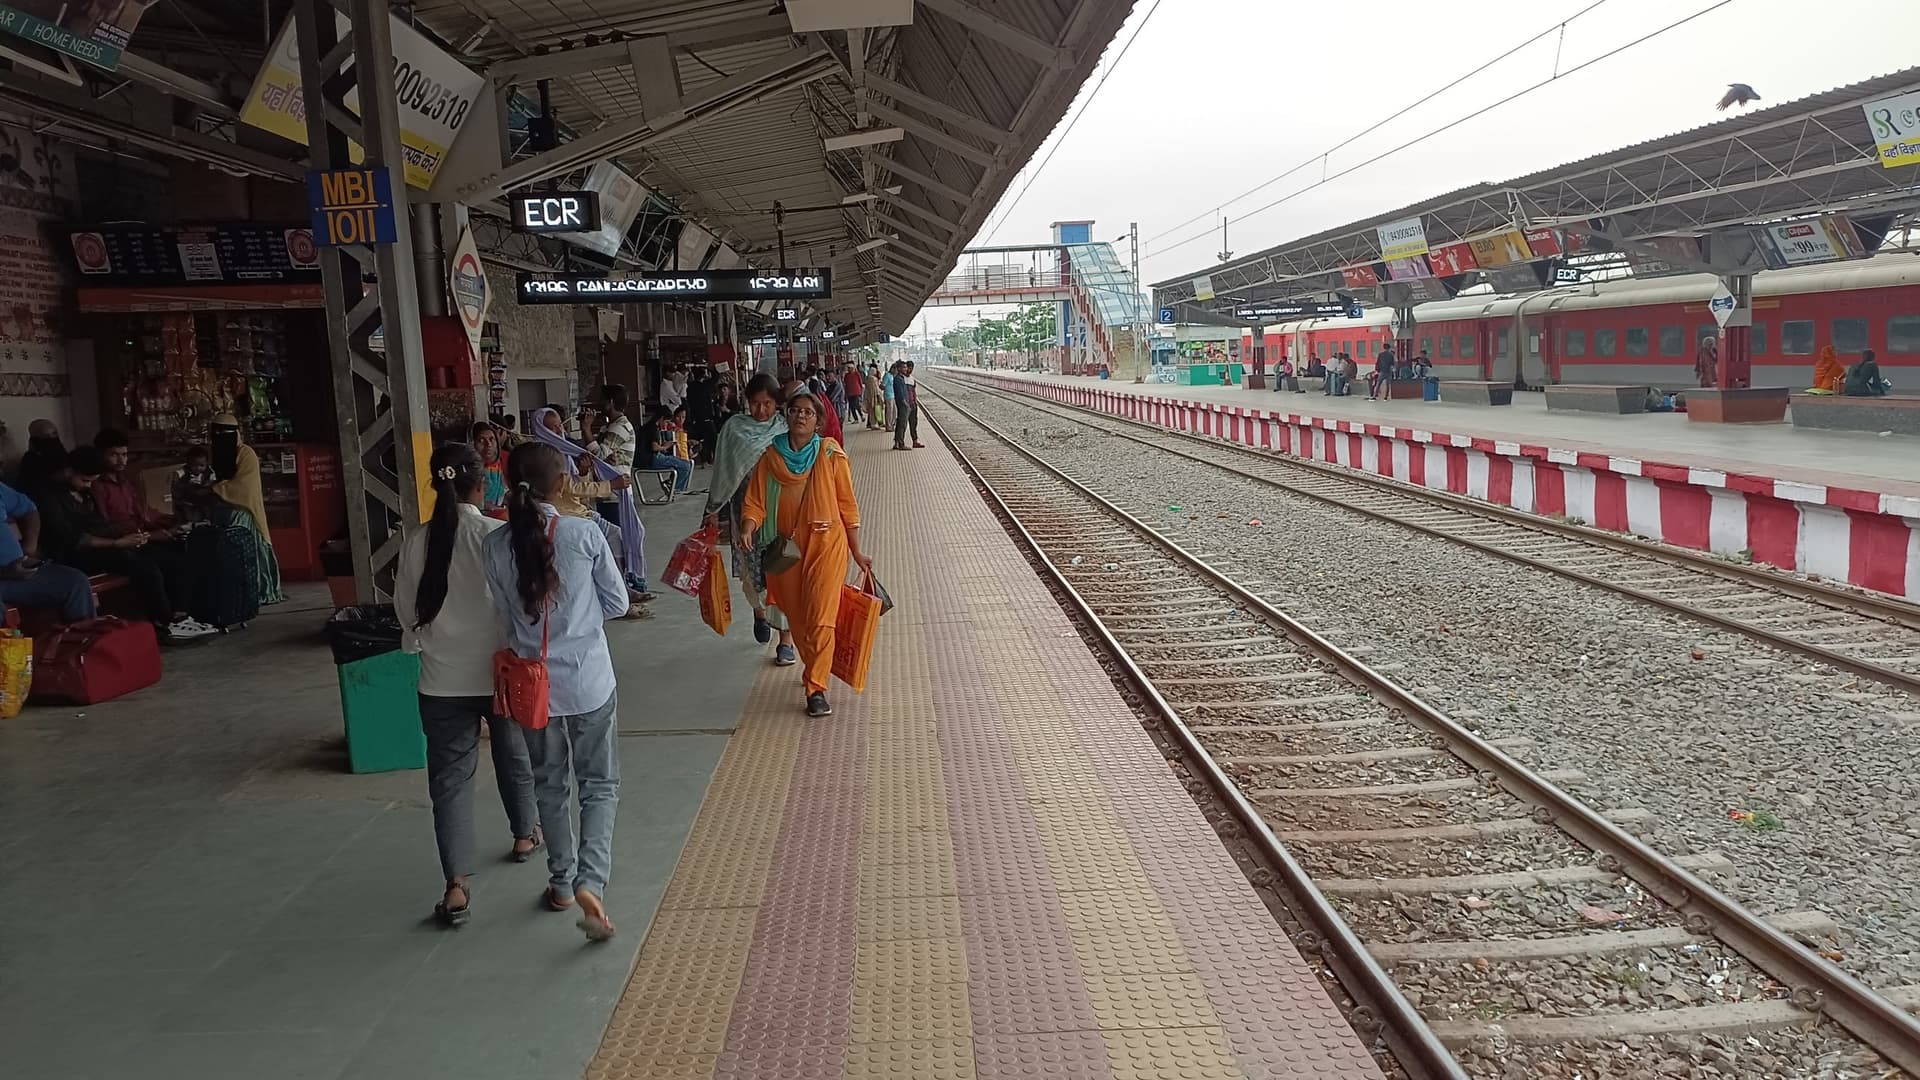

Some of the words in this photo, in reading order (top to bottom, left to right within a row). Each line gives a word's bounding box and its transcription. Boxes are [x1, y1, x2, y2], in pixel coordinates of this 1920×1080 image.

[33, 24, 70, 47] HOME
[69, 39, 103, 60] NEEDS
[321, 170, 377, 206] MBI
[524, 197, 581, 227] ECR
[1557, 268, 1577, 280] ECR
[777, 309, 796, 320] ECR
[1164, 311, 1171, 321] 2
